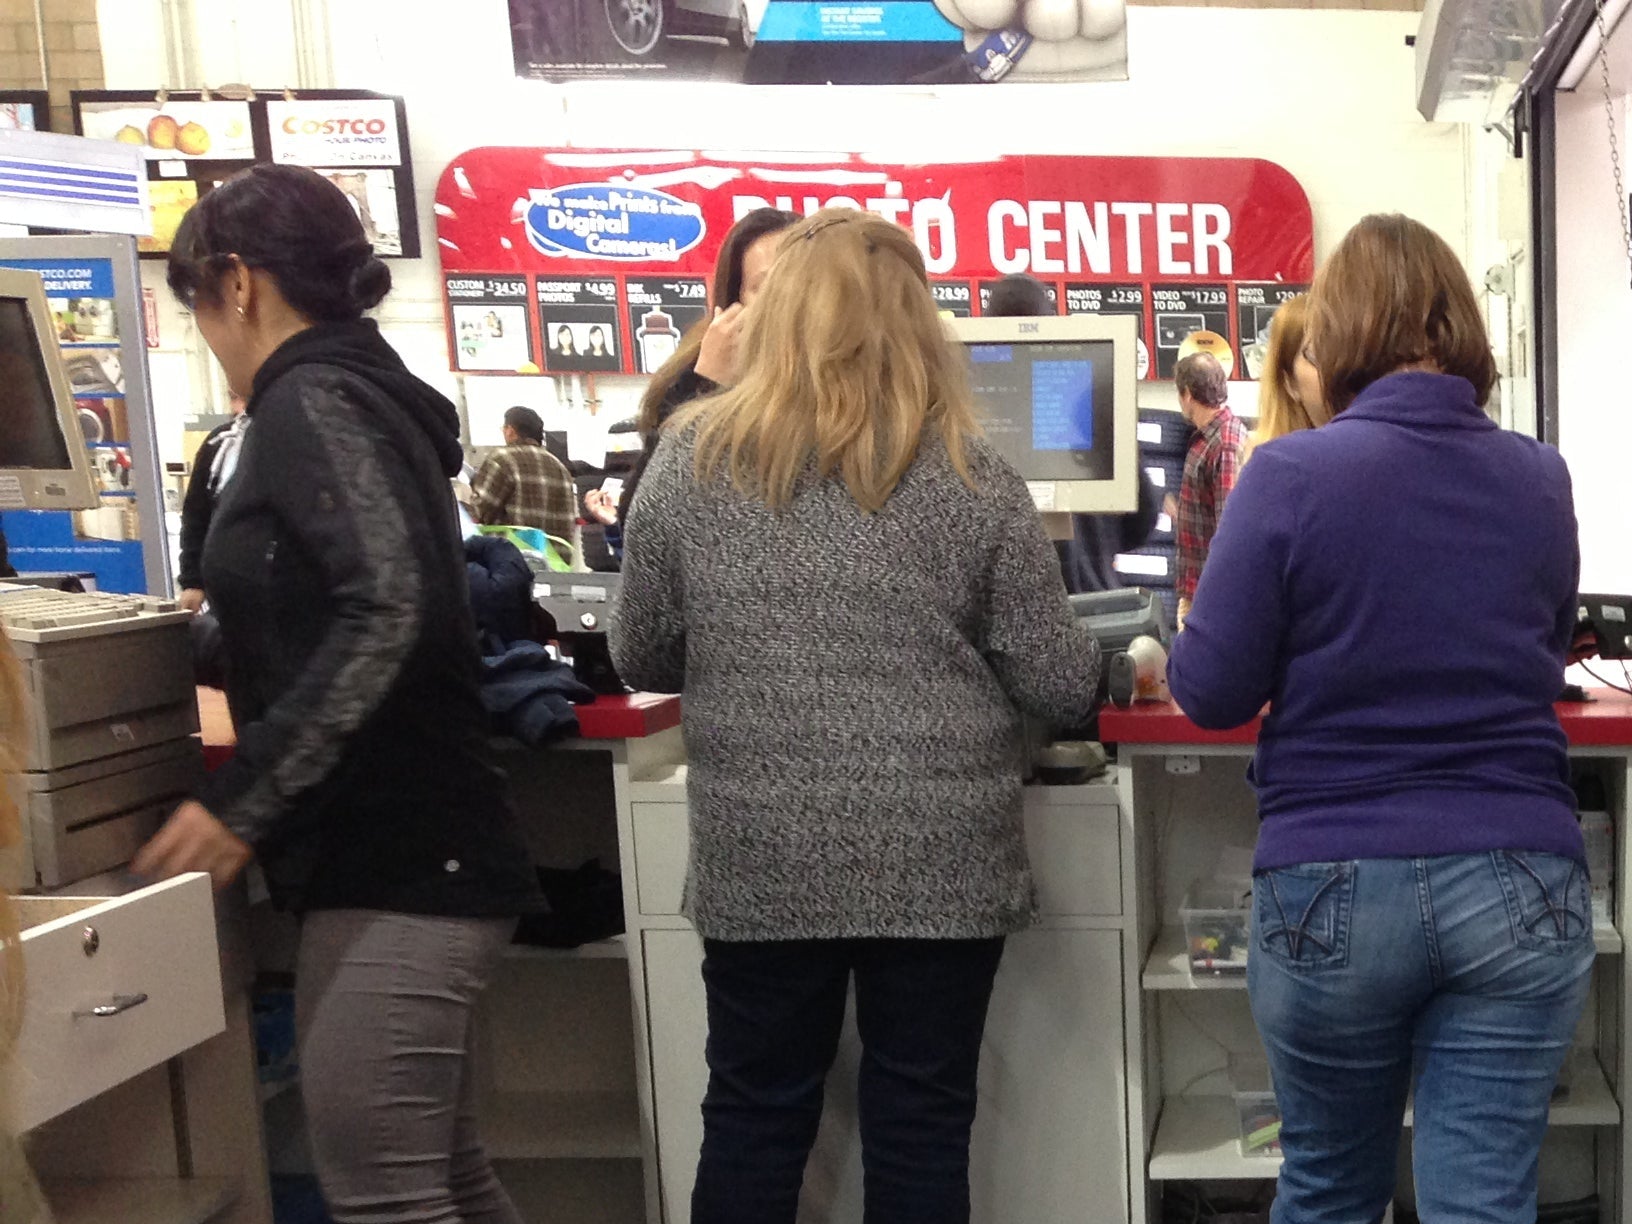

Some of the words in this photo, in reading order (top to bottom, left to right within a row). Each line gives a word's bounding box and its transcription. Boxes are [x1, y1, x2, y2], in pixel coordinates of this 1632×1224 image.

[282, 116, 386, 135] COSTCO
[547, 208, 630, 238] Digital
[986, 199, 1233, 275] CENTER
[39, 268, 92, 279] STCO.COM
[447, 279, 485, 290] CUSTOM
[536, 281, 581, 293] PASSPORT
[1066, 289, 1102, 300] PHOTOS
[1111, 289, 1142, 303] $2.99
[1152, 290, 1180, 300] VIDEO
[1237, 287, 1264, 296] PHOTO
[537, 292, 576, 303] PHOTOS
[1067, 300, 1080, 310] TO
[1081, 300, 1101, 310] DVD
[1154, 300, 1166, 310] TO
[1166, 300, 1187, 310] DVD
[1018, 323, 1039, 333] IBM
